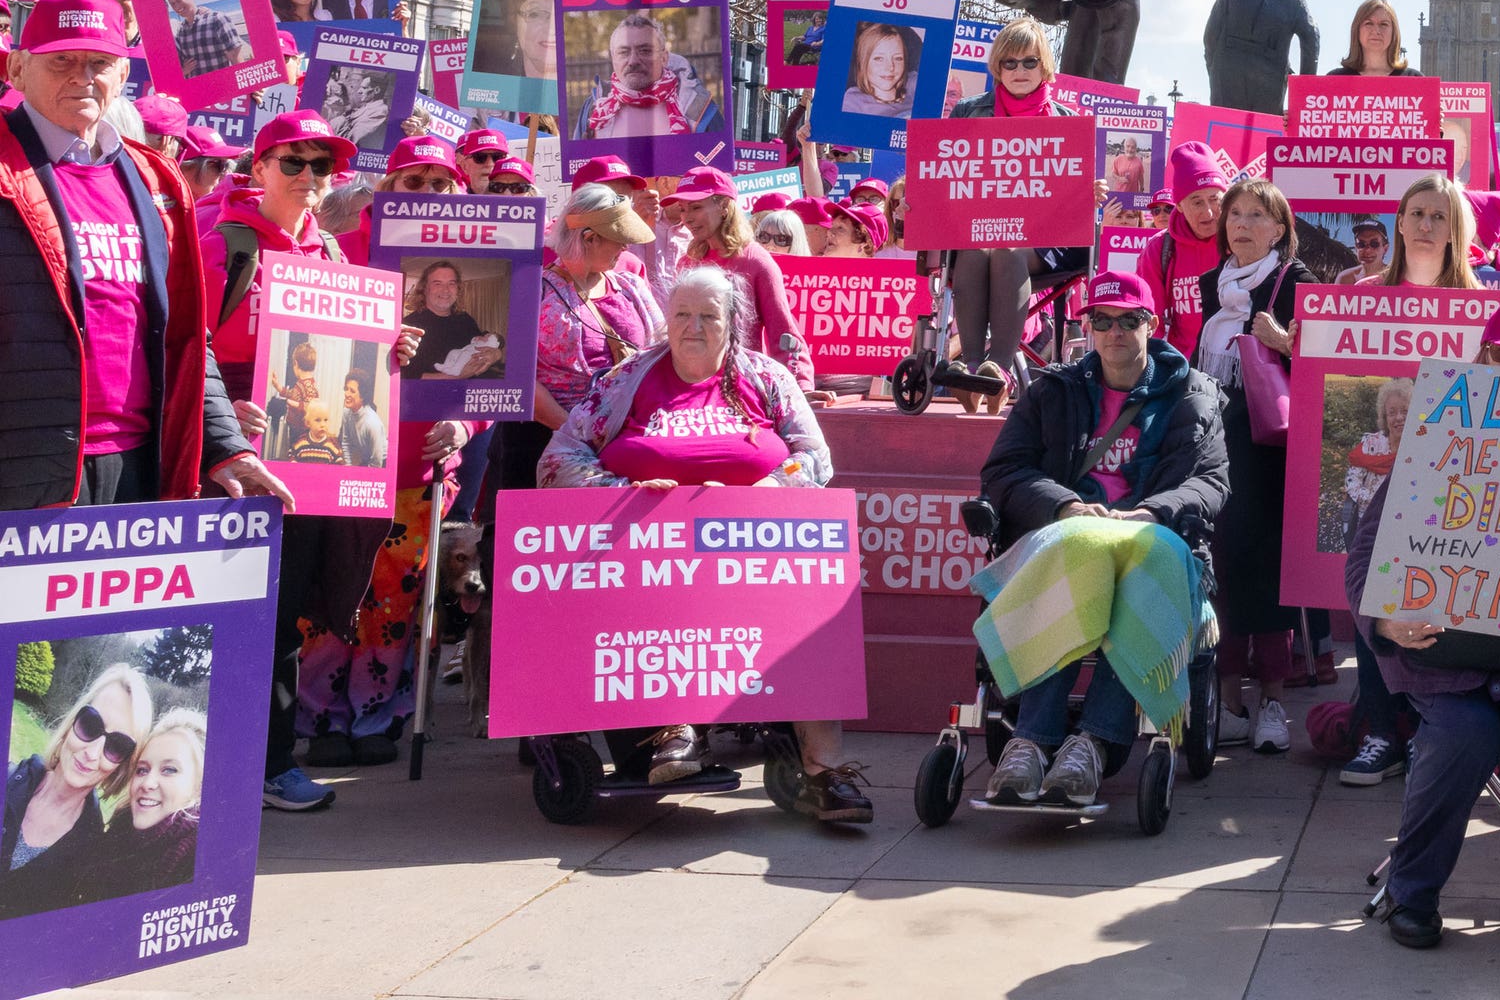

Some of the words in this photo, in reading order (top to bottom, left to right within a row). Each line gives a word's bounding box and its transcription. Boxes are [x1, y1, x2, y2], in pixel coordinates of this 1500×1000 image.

[320, 32, 389, 50] CAMPAIGN
[393, 42, 420, 54] FOR
[349, 49, 386, 66] LEX
[236, 63, 277, 81] DIGNITY
[237, 80, 249, 89] IN
[250, 71, 281, 86] DYING.
[1058, 89, 1078, 103] ME
[1306, 96, 1328, 109] SO
[1333, 96, 1360, 108] MY
[1364, 96, 1423, 110] FAMILY
[1098, 106, 1144, 116] CAMPAIGN
[1146, 110, 1164, 118] FOR
[1300, 110, 1394, 124] REMEMBER
[1399, 112, 1428, 126] ME,
[1102, 117, 1158, 129] HOWARD
[1298, 125, 1333, 138] NOT
[1337, 126, 1364, 138] MY
[1368, 126, 1429, 139] DEATH.
[741, 149, 778, 161] WISH:
[938, 139, 971, 158] SO
[978, 140, 984, 157] I
[992, 137, 1064, 157] DON'T
[1274, 145, 1392, 164] CAMPAIGN
[1402, 147, 1446, 164] FOR
[919, 160, 983, 180] HAVE
[990, 159, 1026, 178] TO
[1030, 158, 1082, 176] LIVE
[950, 182, 973, 200] IN
[981, 180, 1052, 198] FEAR.
[1334, 173, 1386, 195] TIM
[383, 202, 490, 218] CAMPAIGN
[496, 205, 536, 220] FOR
[420, 224, 497, 244] BLUE
[972, 222, 1023, 234] DIGNITY
[972, 232, 986, 242] IN
[988, 230, 1028, 242] DYING.
[272, 263, 360, 290] CAMPAIGN
[365, 278, 395, 297] FOR
[282, 288, 384, 324] CHRISTL
[1335, 328, 1464, 358] ALISON
[464, 404, 477, 412] IN
[480, 404, 524, 412] DYING.
[466, 394, 522, 404] DIGNITY
[1435, 436, 1498, 476] ME
[338, 496, 350, 506] IN
[352, 498, 388, 508] DYING.
[340, 486, 386, 498] DIGNITY
[514, 524, 613, 556] GIVE
[630, 522, 686, 549] ME
[700, 522, 845, 549] CHOICE
[1409, 535, 1482, 559] WHEN
[512, 560, 624, 592] OVER
[642, 558, 703, 587] MY
[718, 558, 845, 586] DEATH
[46, 564, 195, 612] PIPPA
[595, 628, 712, 648] CAMPAIGN
[720, 627, 762, 643] FOR
[594, 642, 762, 676] DIGNITY
[594, 675, 634, 702] IN
[643, 670, 774, 700] DYING.
[143, 901, 208, 922] CAMPAIGN
[212, 894, 237, 907] FOR
[140, 905, 236, 942] DIGNITY
[139, 937, 162, 959] IN
[167, 922, 238, 952] DYING.
